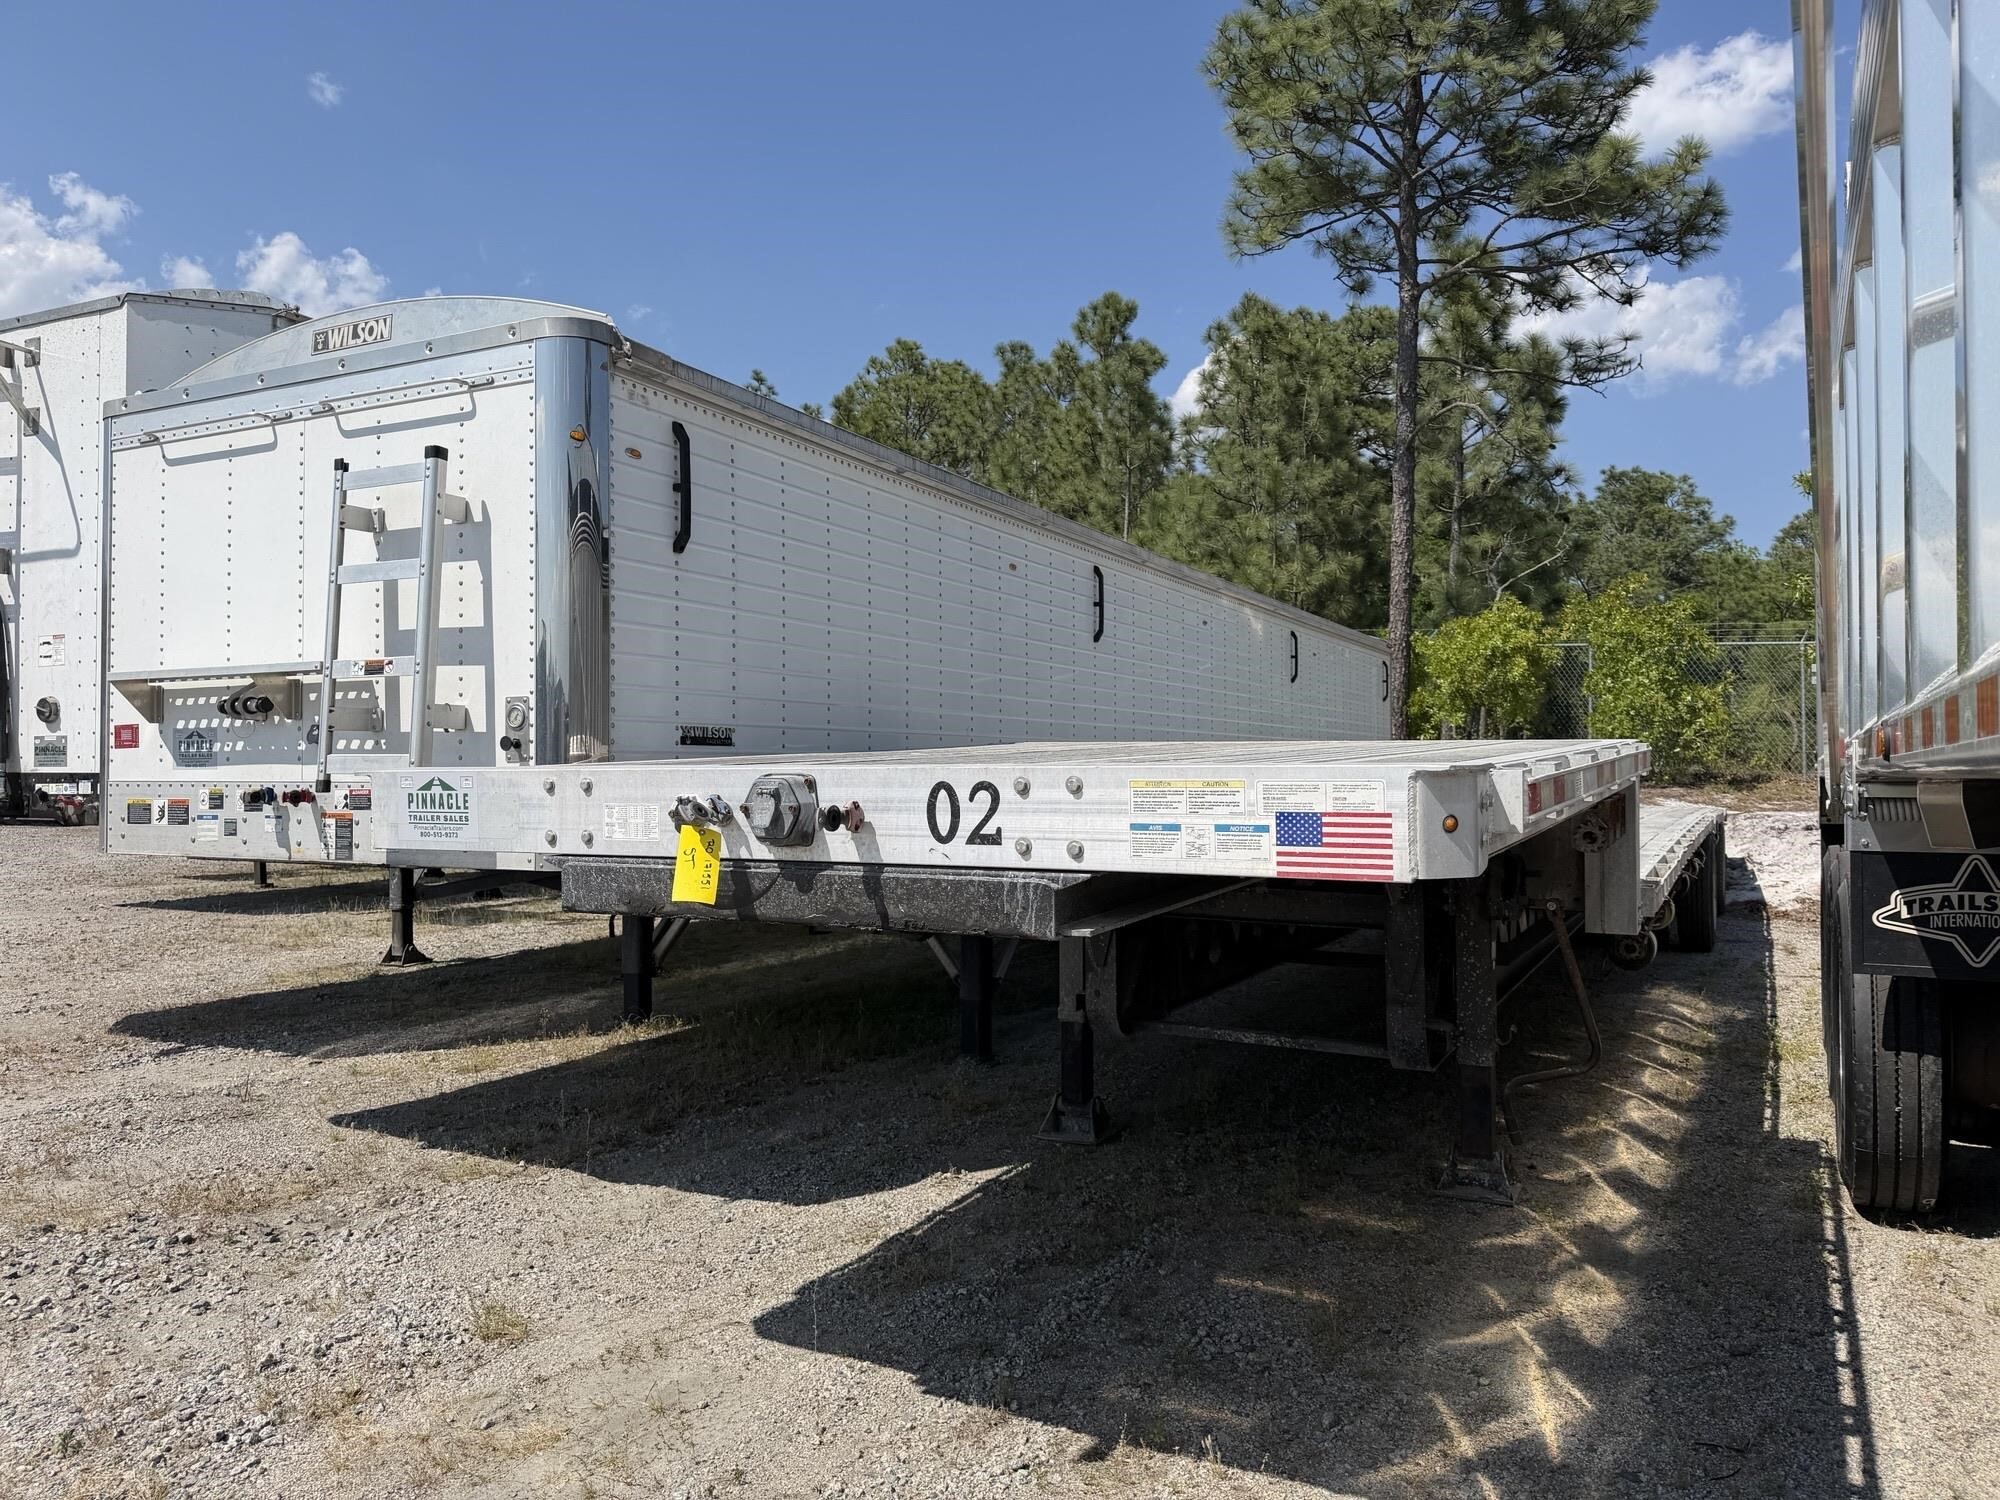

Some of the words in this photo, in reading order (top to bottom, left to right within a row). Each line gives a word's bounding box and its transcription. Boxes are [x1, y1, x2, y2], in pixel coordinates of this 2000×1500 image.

[327, 317, 390, 350] WILSON
[694, 726, 733, 739] WILSON
[35, 745, 67, 753] PINNACLE
[407, 792, 470, 811] PINNACLE
[408, 814, 441, 822] TRAILER
[443, 814, 470, 823] SALES
[926, 780, 1003, 846] 02
[1903, 894, 2000, 916] TRAILS
